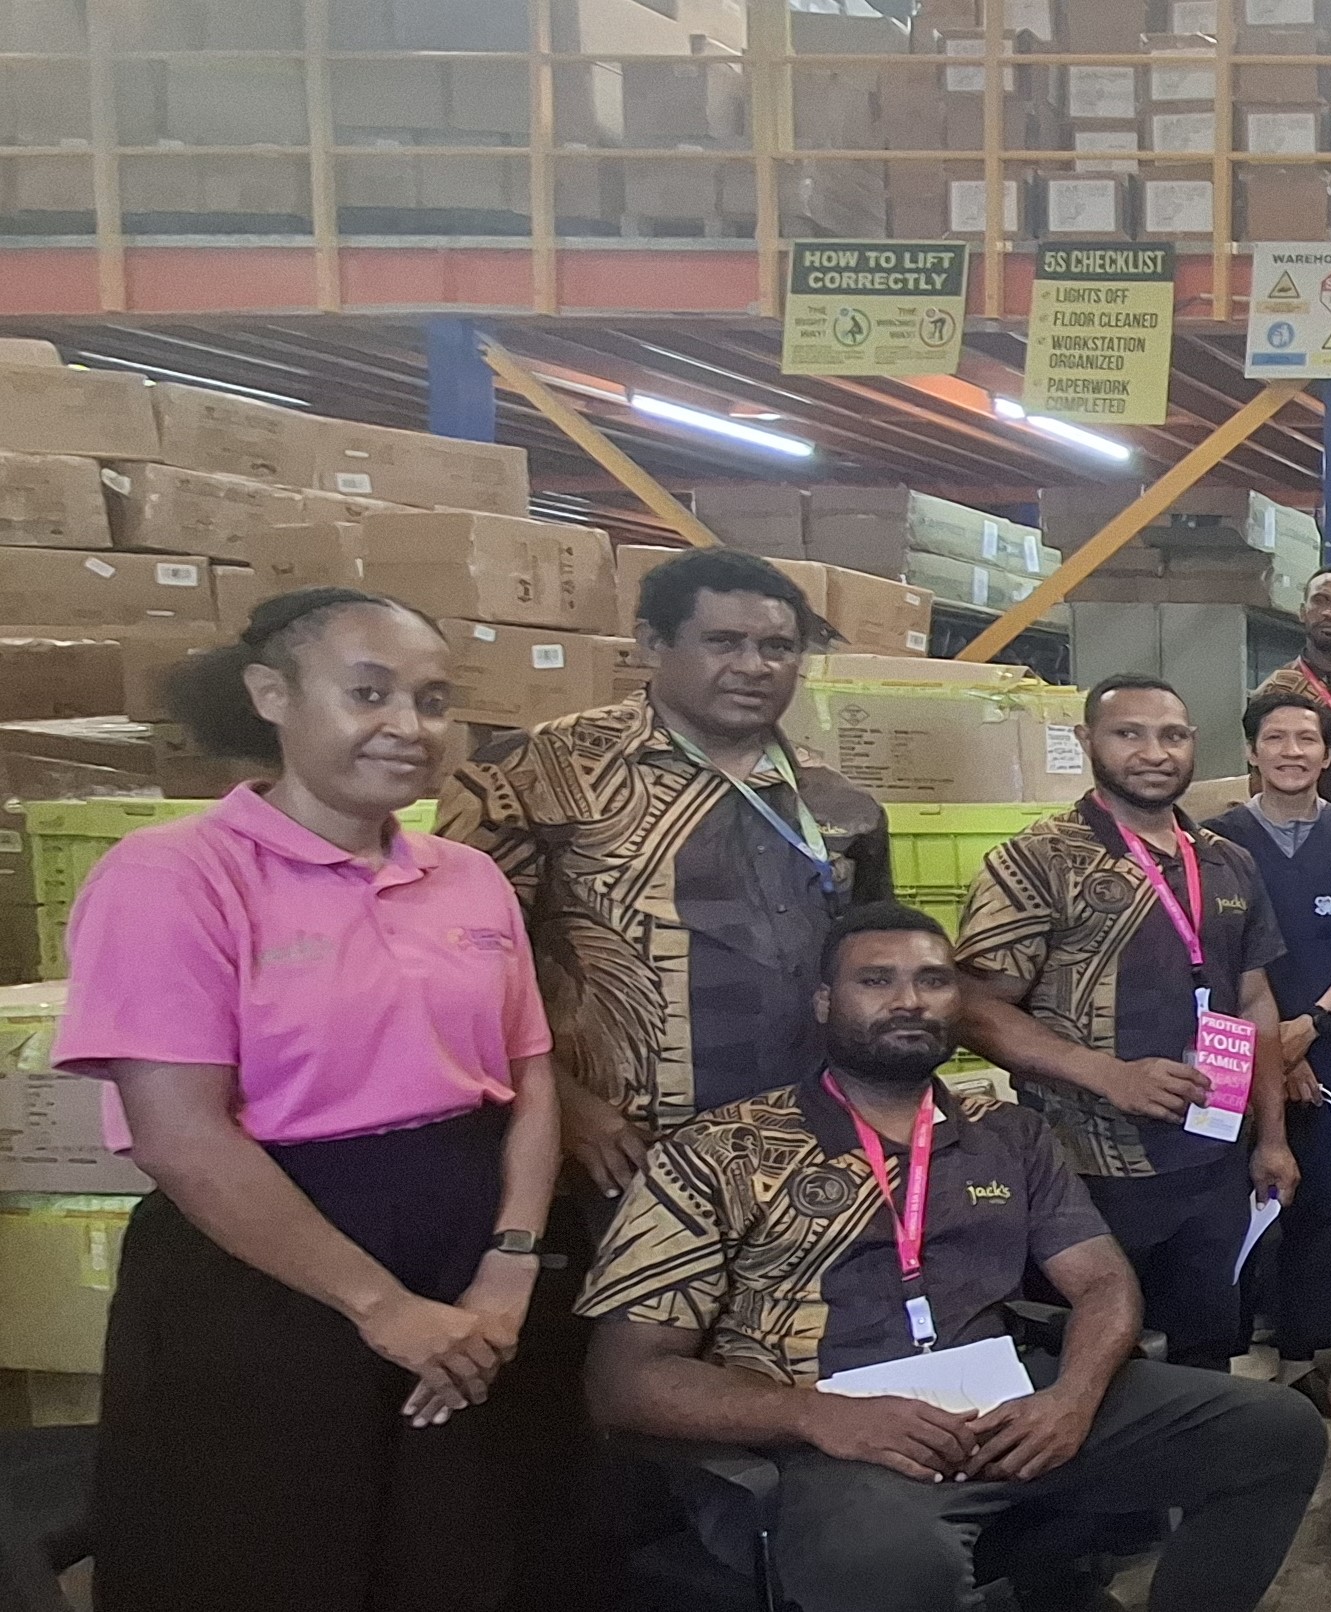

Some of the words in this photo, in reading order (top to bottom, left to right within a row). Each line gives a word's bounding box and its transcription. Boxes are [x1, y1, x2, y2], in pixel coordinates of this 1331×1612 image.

[804, 250, 859, 268] HOW
[865, 251, 896, 269] TO
[904, 252, 954, 269] LIFT
[1044, 251, 1067, 273] 5S
[1071, 251, 1165, 274] CHECKLIST
[808, 271, 948, 290] CORRECTLY
[1056, 287, 1101, 303] LIGHTS
[1105, 288, 1130, 304] OFF
[1053, 311, 1095, 327] FLOOR
[1100, 312, 1158, 328] CLEANED
[1051, 334, 1146, 352] WORKSTATION
[1049, 353, 1124, 370] ORGANIZED
[1047, 377, 1130, 395] PAPERWORK
[1046, 396, 1126, 414] COMPLETED
[1202, 1016, 1251, 1037] PROTECT
[1201, 1031, 1251, 1056] YOUR
[1199, 1051, 1251, 1073] FAMILY
